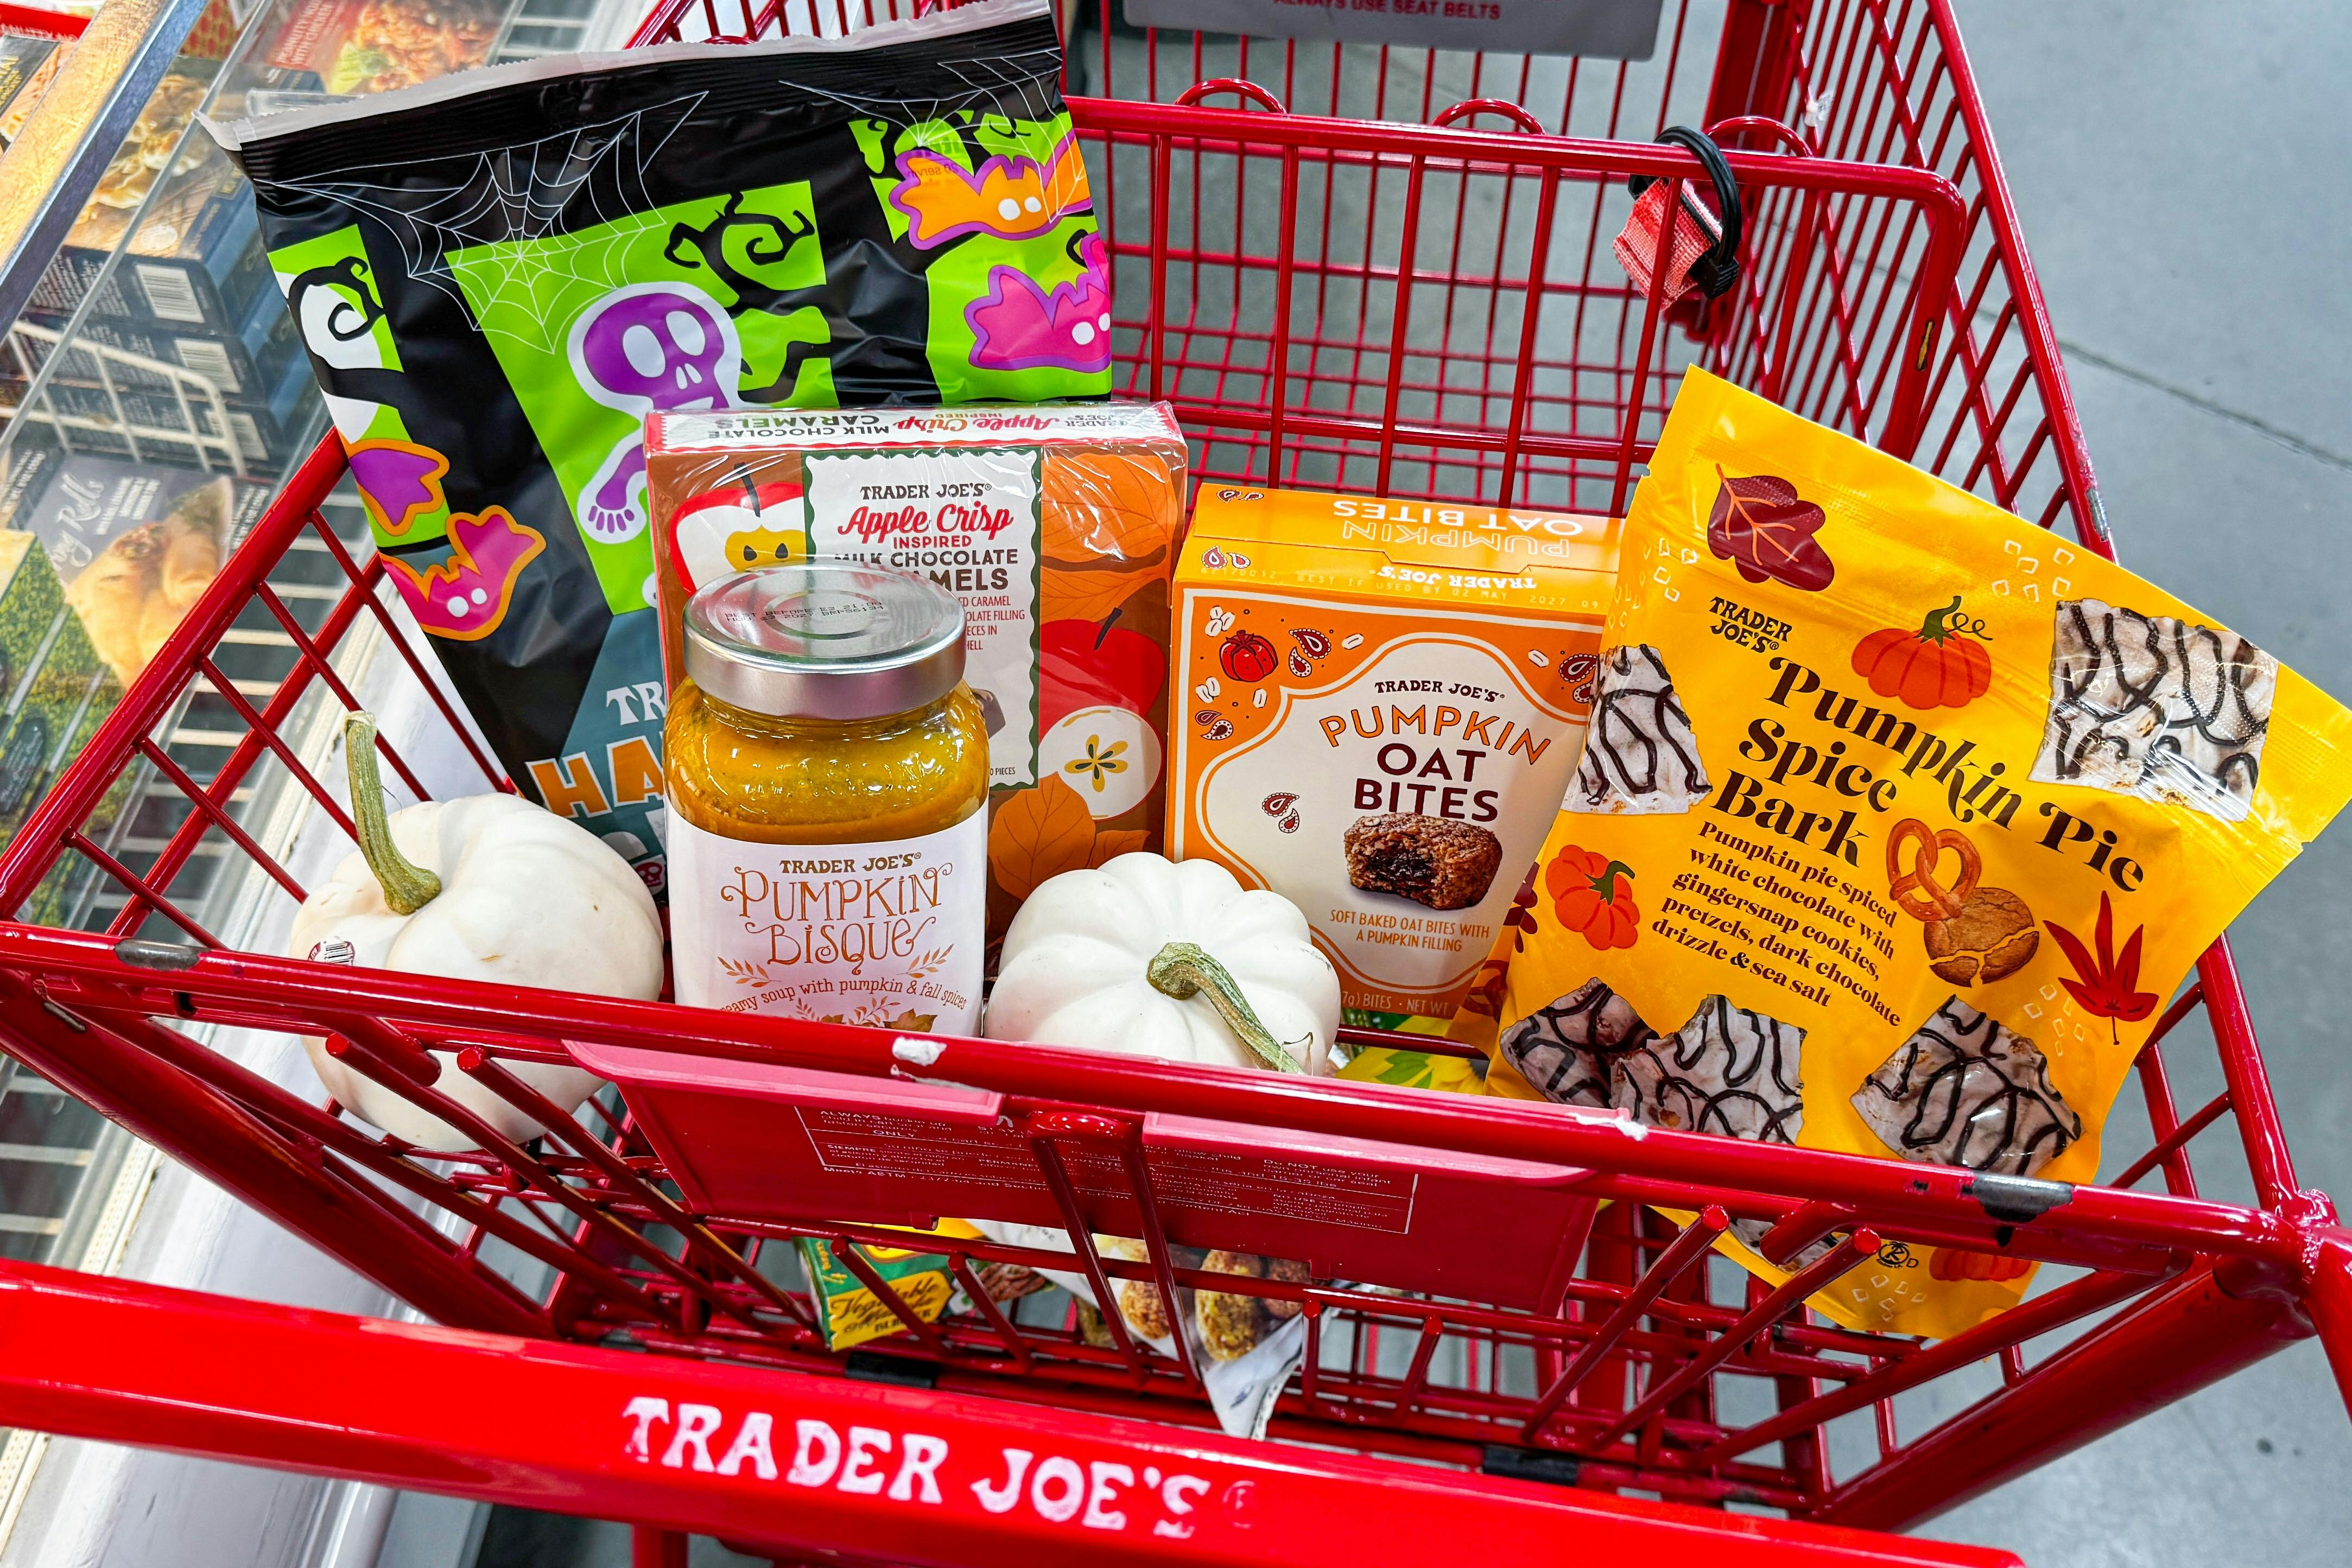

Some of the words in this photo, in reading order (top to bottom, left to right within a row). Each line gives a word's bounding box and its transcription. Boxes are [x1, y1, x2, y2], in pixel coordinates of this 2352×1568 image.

[1351, 0, 1388, 13] USE
[1392, 0, 1437, 16] SEAT
[1443, 2, 1501, 20] BELTS
[708, 428, 836, 439] CHOCOLATE
[716, 415, 880, 429] CARAMELS
[842, 426, 889, 434] MILK
[894, 416, 967, 433] Crisp
[975, 414, 1060, 431] Apple
[860, 484, 930, 500] TRADER
[838, 505, 931, 544] Apple
[936, 500, 1014, 541] Crisp
[1333, 500, 1465, 528] BITES
[1478, 513, 1583, 536] OAT
[893, 535, 973, 550] INSPIRED
[1342, 520, 1570, 558] PUMPKIN
[890, 549, 1018, 568] CHOCOLATE
[1297, 574, 1335, 585] BEST
[1348, 578, 1365, 587] IF
[1375, 582, 1412, 592] USED
[1423, 585, 1441, 595] BY
[1481, 590, 1508, 600] MAY
[1530, 595, 1567, 606] 2027
[1449, 574, 1538, 589] TRADER
[971, 595, 1011, 607] CARAMEL
[966, 610, 992, 621] OLATE
[993, 610, 1025, 621] FILLING
[1709, 596, 1793, 643] TRADER
[967, 625, 986, 636] ECES
[988, 625, 998, 636] IN
[967, 640, 984, 651] HELL
[1374, 680, 1443, 694] TRADER
[1319, 704, 1551, 765] PUMPKIN
[995, 766, 1016, 776] PIECES
[1377, 742, 1486, 782] OAT
[1738, 718, 1897, 813] Spice
[1764, 656, 2023, 831] Pumpkin
[2036, 801, 2145, 894] Pie
[1354, 778, 1499, 822] BITES
[1708, 769, 1869, 868] Bark
[779, 859, 856, 874] TRADER
[1697, 820, 1800, 874] Pumpkin
[1801, 865, 1839, 889] pie
[1839, 881, 1898, 929] spiced
[1690, 848, 1751, 883] white
[1752, 875, 1855, 928] chocolate
[1859, 921, 1894, 961] with
[1329, 909, 1356, 924] SOFT
[1359, 912, 1397, 929] BAKED
[1400, 917, 1424, 932] OAT
[1426, 920, 1456, 935] BITES
[1459, 924, 1489, 938] WITH
[1672, 872, 1800, 935] gingersnap
[1801, 925, 1881, 982] cookies,
[1356, 929, 1364, 942] A
[1367, 930, 1420, 948] PUMPKIN
[1422, 937, 1462, 952] FILLING
[1652, 918, 1728, 961] drizzle
[1729, 951, 1751, 969] &
[1749, 961, 1786, 987] sea
[1789, 979, 1834, 1008] salt
[1660, 896, 1754, 946] pretzels,
[1758, 934, 1812, 969] dark
[1815, 961, 1902, 1028] chocolate
[720, 996, 758, 1012] eamy
[763, 985, 796, 1004] soup
[800, 977, 834, 996] with
[839, 977, 903, 995] pumpkin
[906, 979, 918, 995] &
[919, 982, 940, 1000] fall
[941, 989, 968, 1010] spices
[1362, 993, 1392, 1009] BITES
[1406, 998, 1425, 1013] NET
[820, 1110, 881, 1120] ALWAYS
[872, 1129, 915, 1138] ONLY
[622, 1396, 949, 1504] TRADER
[970, 1446, 1212, 1540] JOE'S
